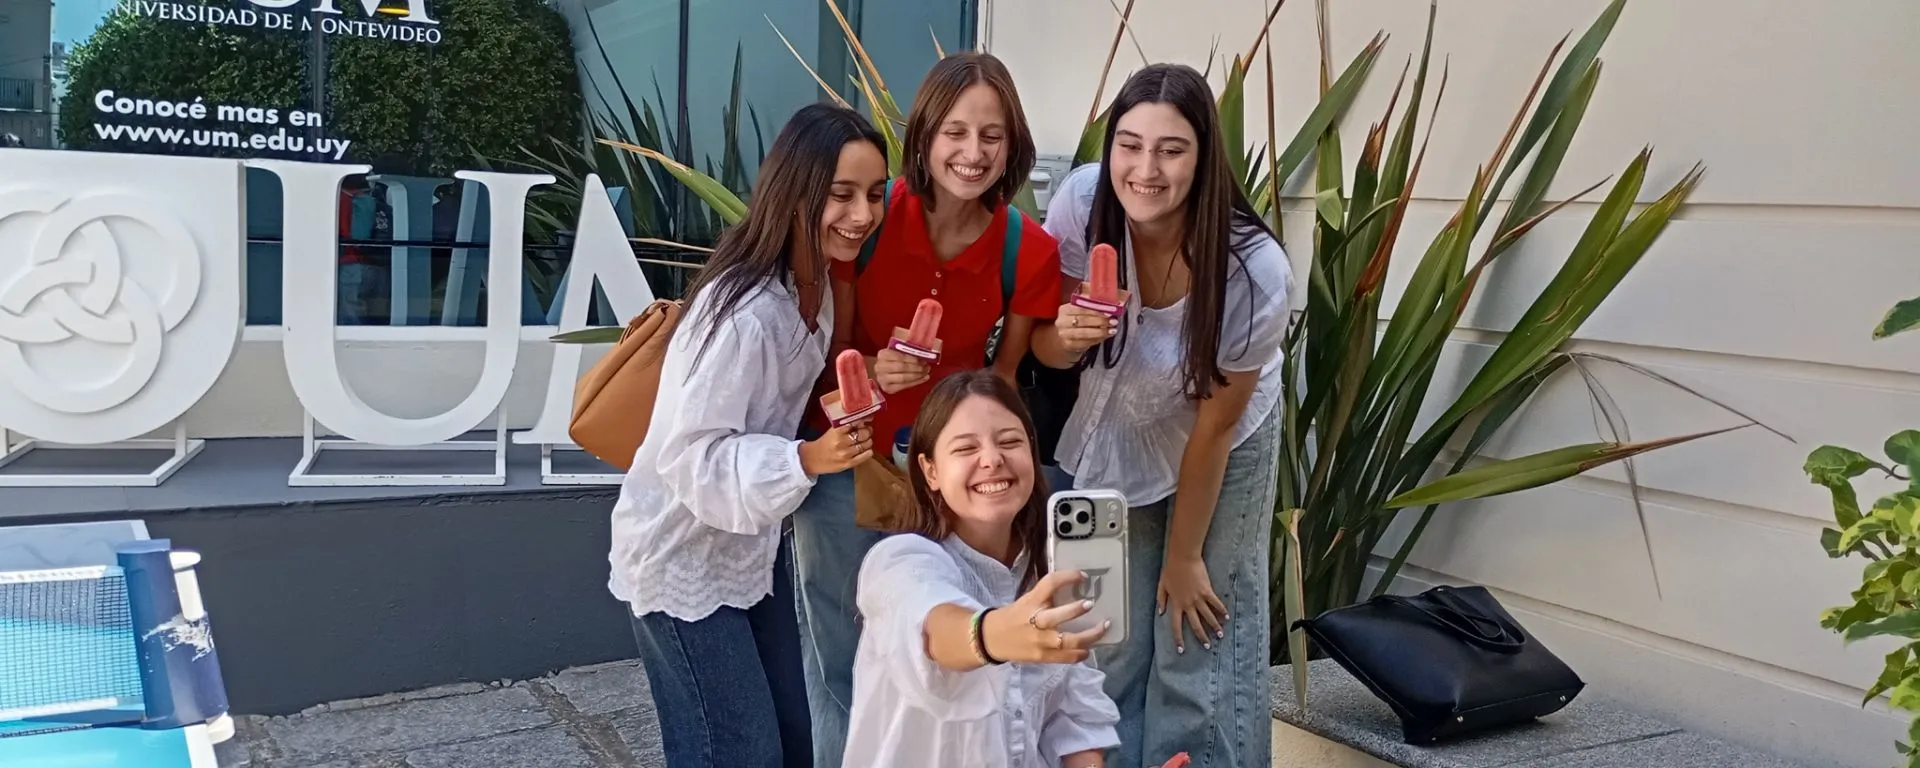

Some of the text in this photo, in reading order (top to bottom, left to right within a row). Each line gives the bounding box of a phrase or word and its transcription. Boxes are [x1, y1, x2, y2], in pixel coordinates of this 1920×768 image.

[104, 0, 258, 27] NIVERSIDAD
[264, 12, 293, 31] DE
[94, 89, 322, 127] Conocé mas en
[94, 122, 350, 160] www.um.edu.uy
